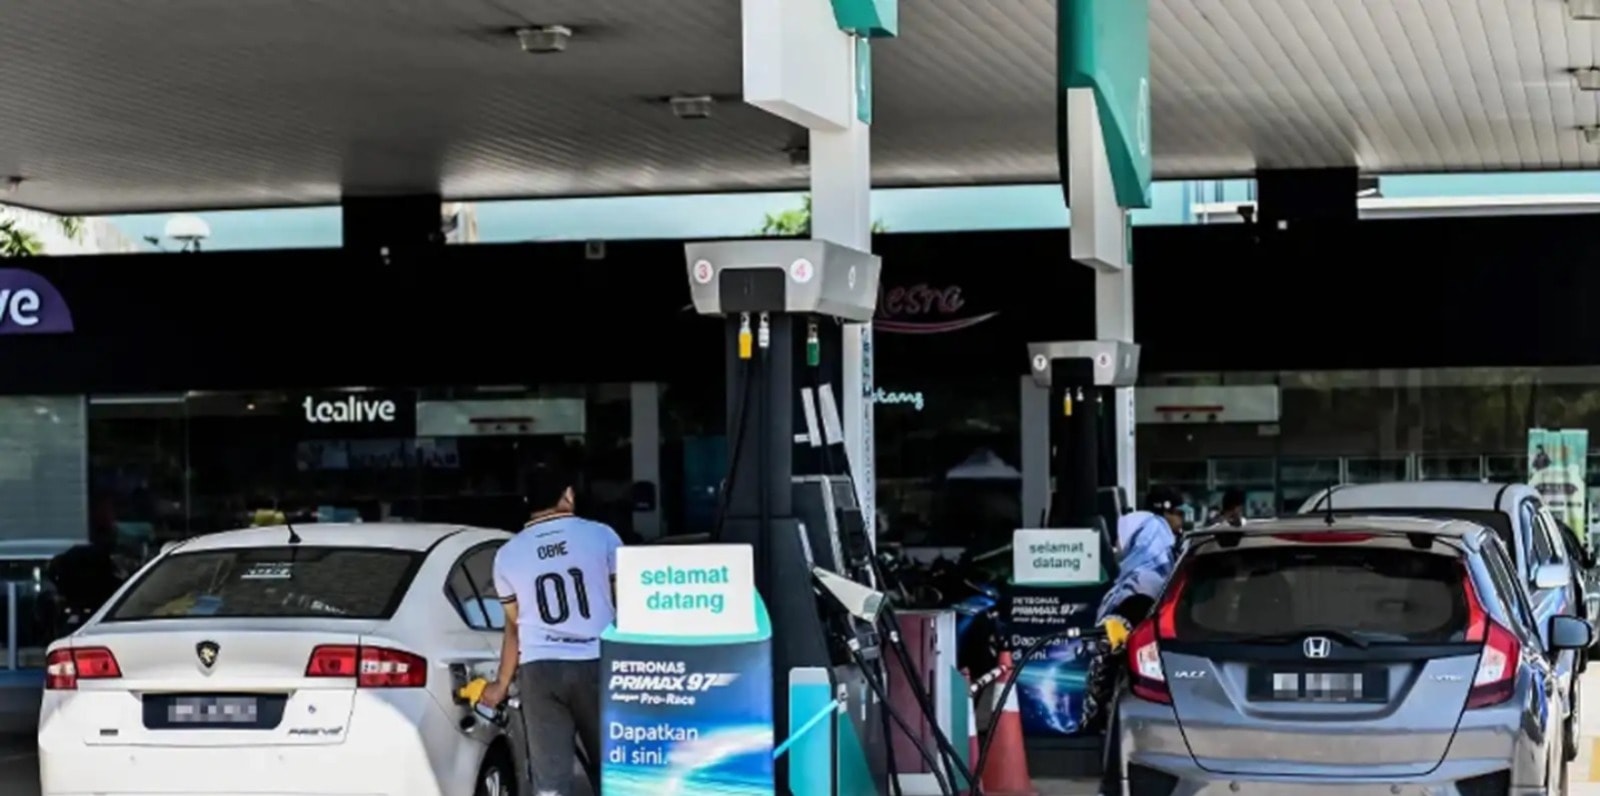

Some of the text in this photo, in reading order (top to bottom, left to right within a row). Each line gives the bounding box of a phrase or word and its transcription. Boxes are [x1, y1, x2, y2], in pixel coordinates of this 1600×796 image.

[698, 263, 709, 281] 3
[794, 262, 807, 280] 4
[880, 284, 965, 317] esra
[302, 395, 396, 422] tealive
[1029, 542, 1084, 554] selamat
[1033, 557, 1081, 571] datang
[640, 565, 729, 585] selamat
[535, 566, 592, 626] 01
[646, 591, 724, 614] datang
[1012, 596, 1060, 605] PETRONAS
[1011, 605, 1059, 616] PRIMAX
[611, 660, 686, 674] PETRONAS
[608, 672, 722, 692] PRIMAX 97
[640, 692, 696, 705] Pro-Race
[609, 721, 699, 744] Dapatkan
[609, 746, 669, 765] di sini.
